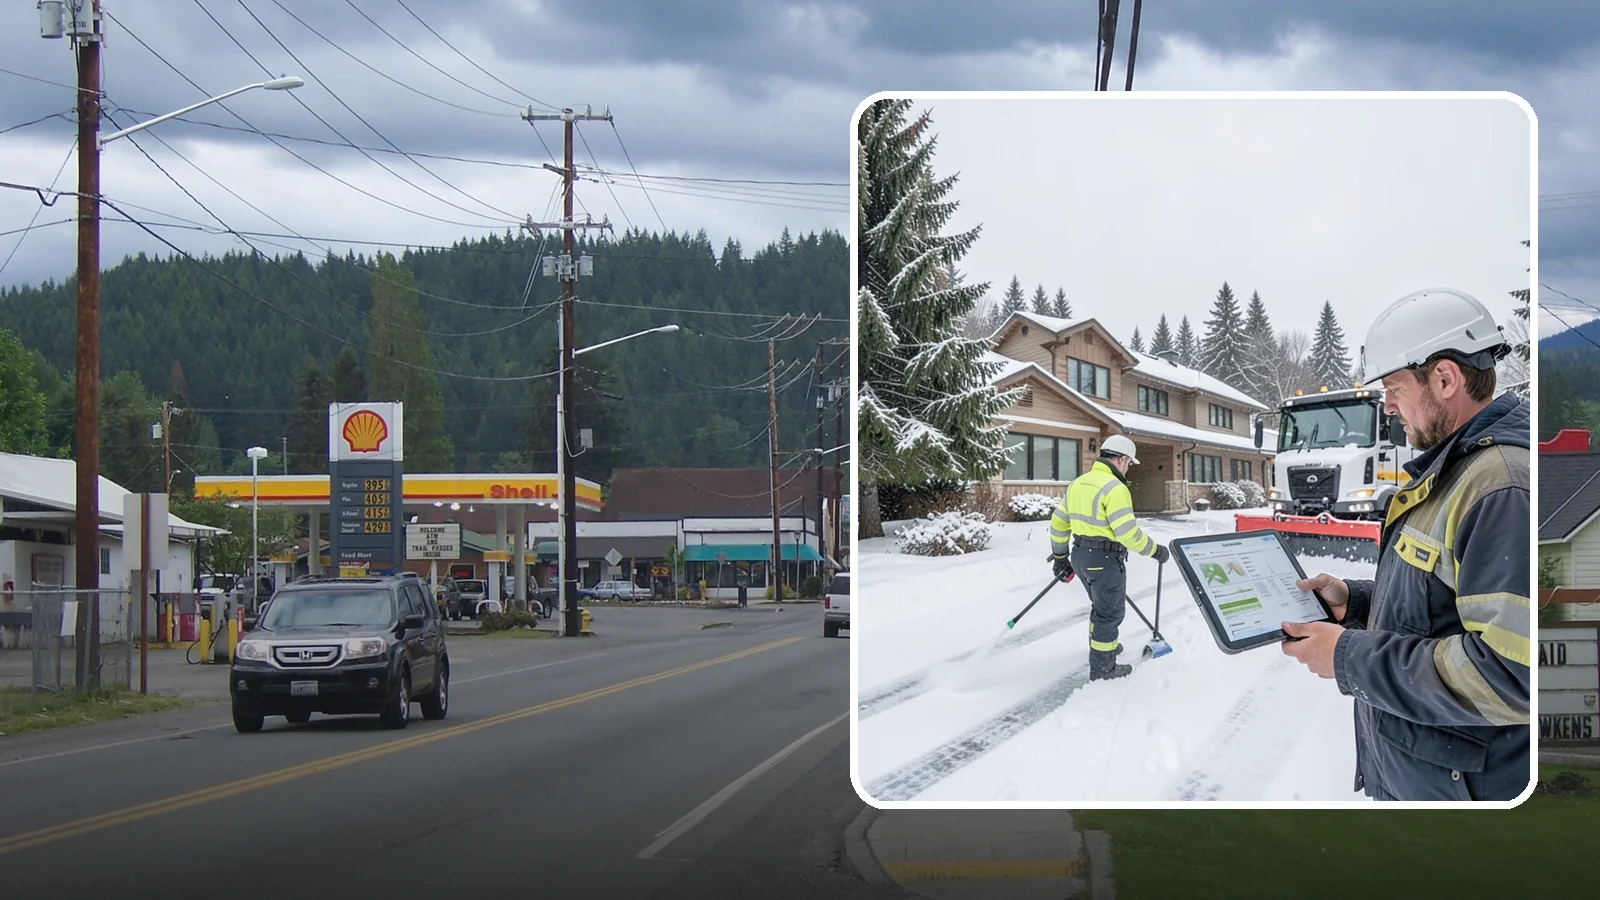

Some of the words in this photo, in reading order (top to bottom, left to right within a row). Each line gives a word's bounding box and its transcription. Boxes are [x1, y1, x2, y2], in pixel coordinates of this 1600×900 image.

[365, 480, 383, 490] 395
[490, 484, 547, 498] Shell
[365, 494, 383, 504] 405
[365, 508, 383, 518] 415
[365, 522, 383, 533] 429
[1538, 643, 1566, 665] AID
[1538, 715, 1592, 738] WKENS
